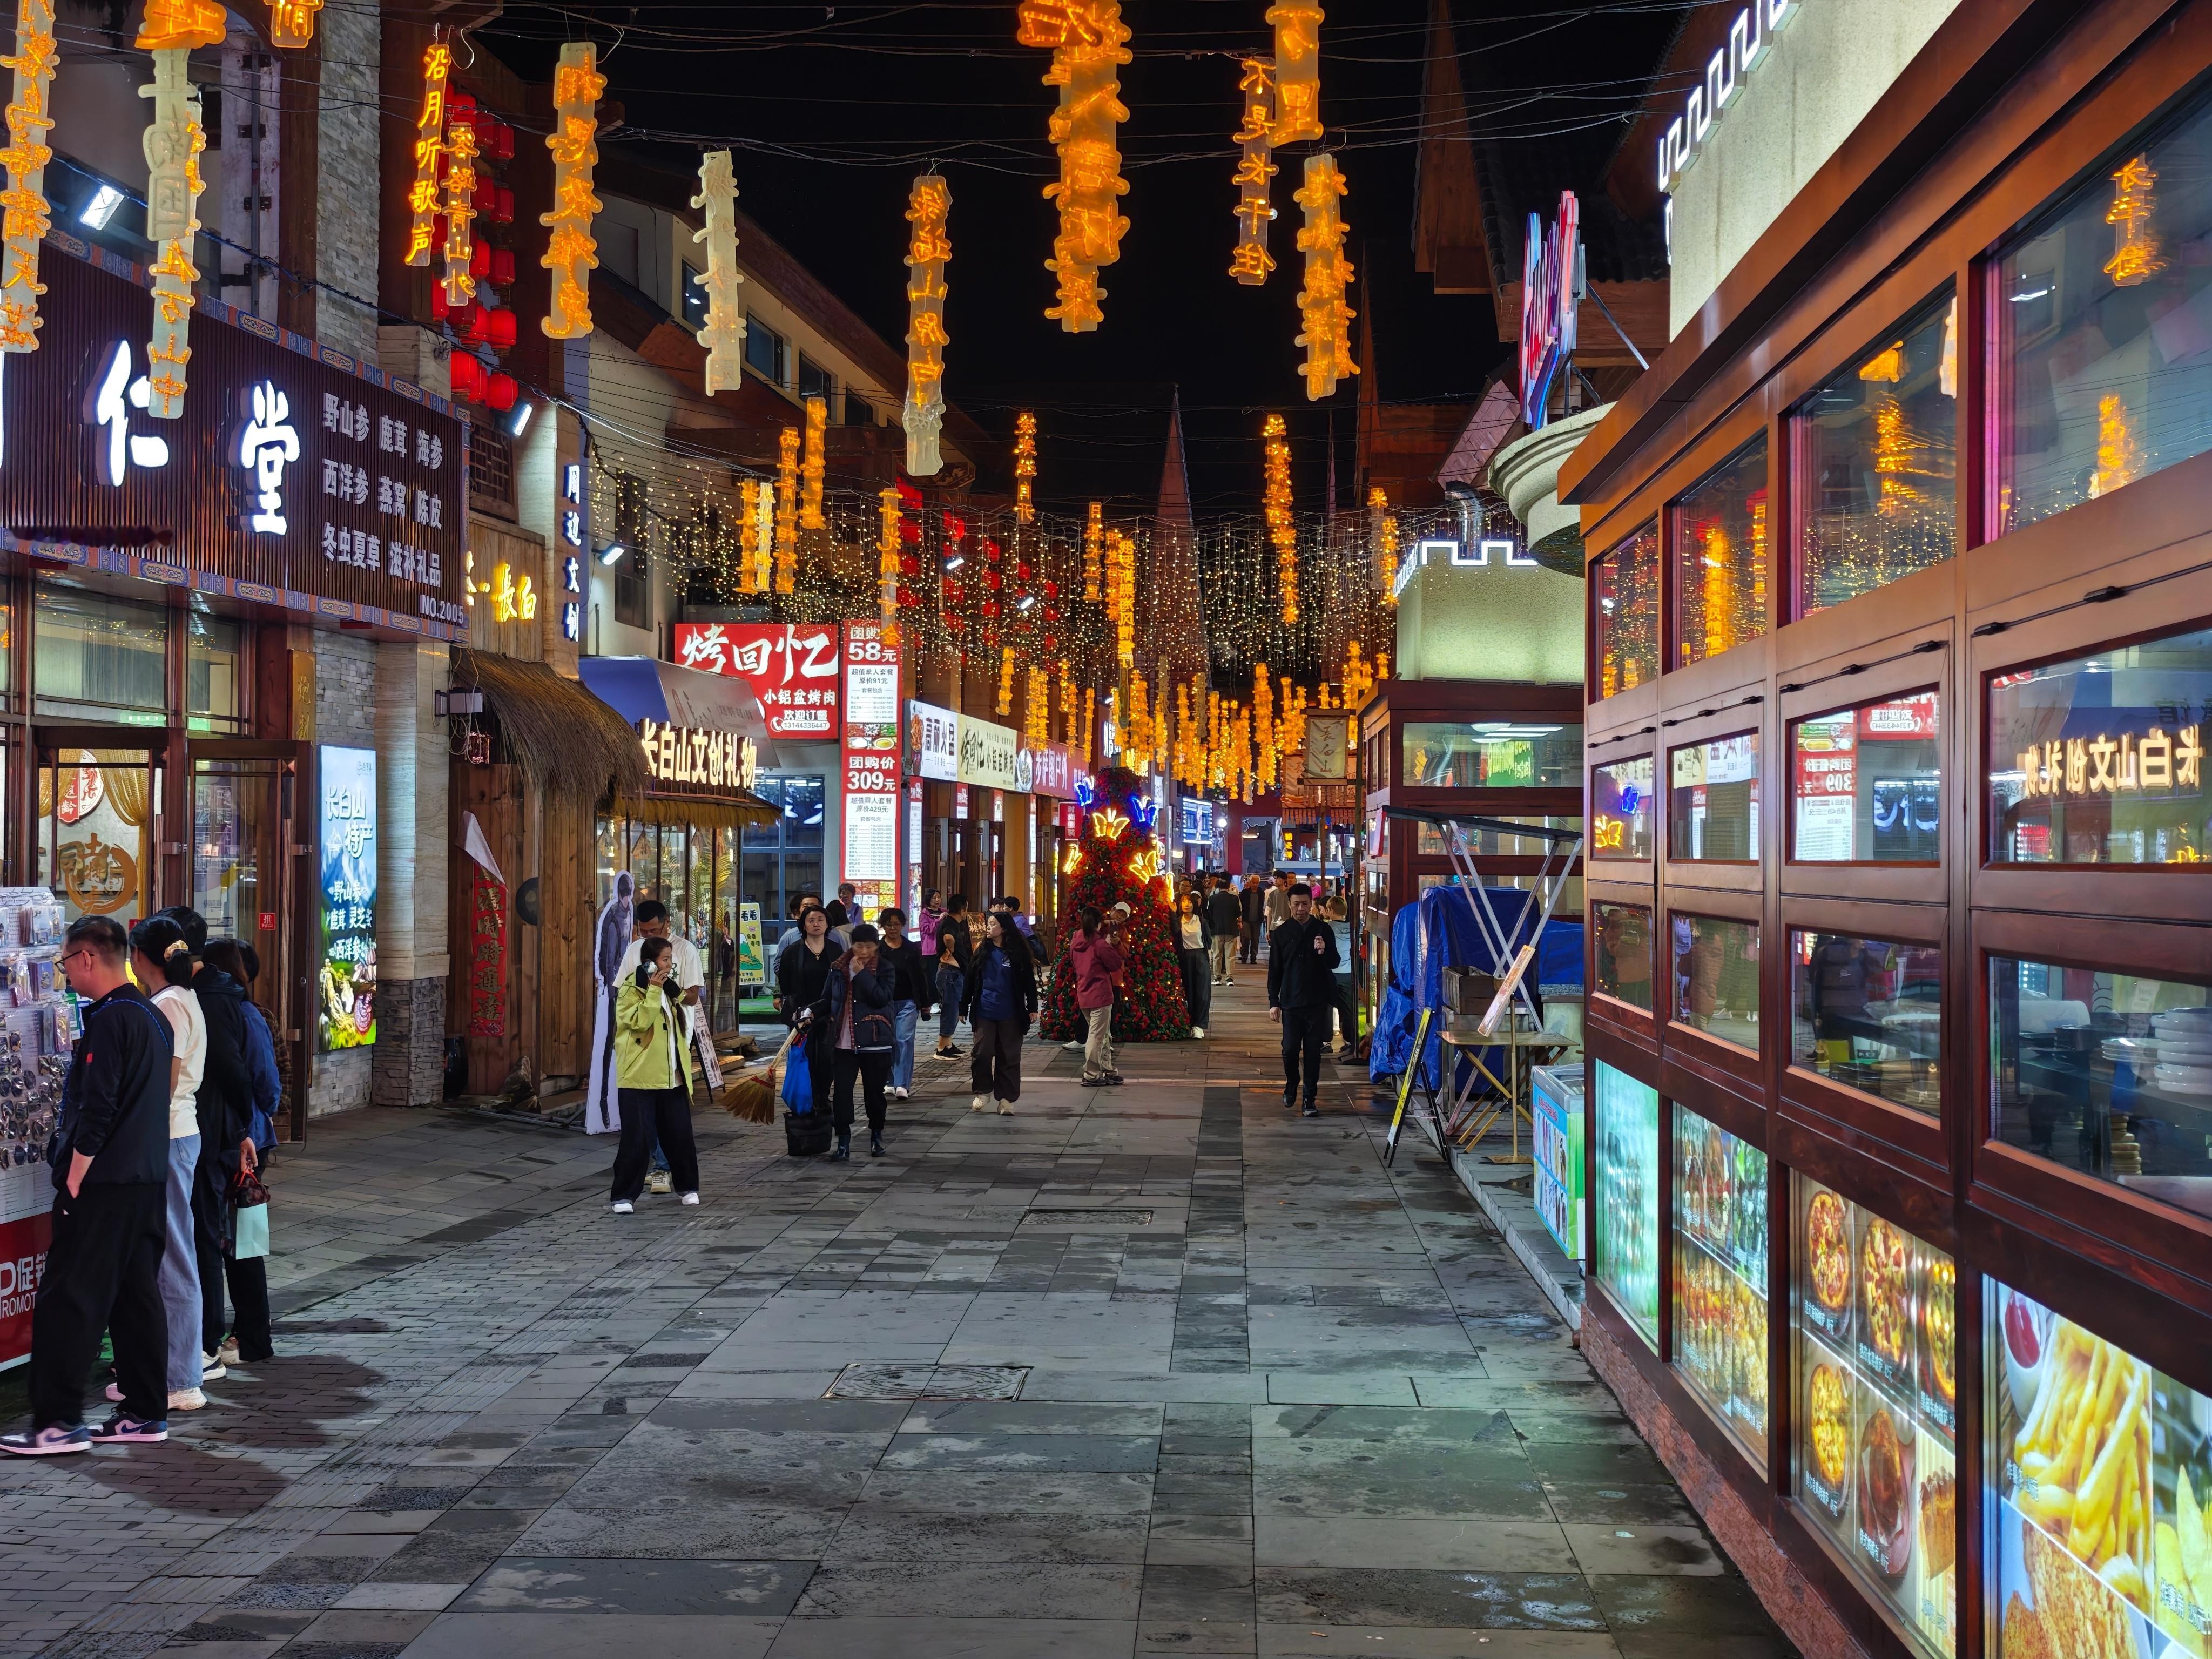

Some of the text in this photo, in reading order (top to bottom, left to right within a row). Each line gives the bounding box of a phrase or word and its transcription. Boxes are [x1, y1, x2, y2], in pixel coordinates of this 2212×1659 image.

[405, 46, 450, 265] 沿月听歌声
[322, 393, 442, 469] 野山参 鹿茸 海参
[322, 458, 442, 530] 西洋参 燕窝 陈皮
[322, 522, 441, 588] 冬虫夏草 滋补礼品
[420, 594, 463, 625] NO.2005
[682, 623, 839, 685] 烤回忆
[848, 642, 897, 662] 58元
[764, 689, 835, 705] 小铝盆烤肉
[784, 710, 827, 721] 欢迎订餐
[642, 718, 757, 790] 长白山文创礼物
[849, 757, 895, 770] 团购价
[847, 771, 896, 791] 309元
[325, 786, 367, 820] 长白山
[345, 820, 373, 858] 特产
[332, 881, 362, 903] 野山参
[264, 914, 272, 923] 推
[328, 907, 365, 932] 鹿茸 灵芝
[741, 909, 757, 922] 看看
[334, 938, 363, 962] 西洋参
